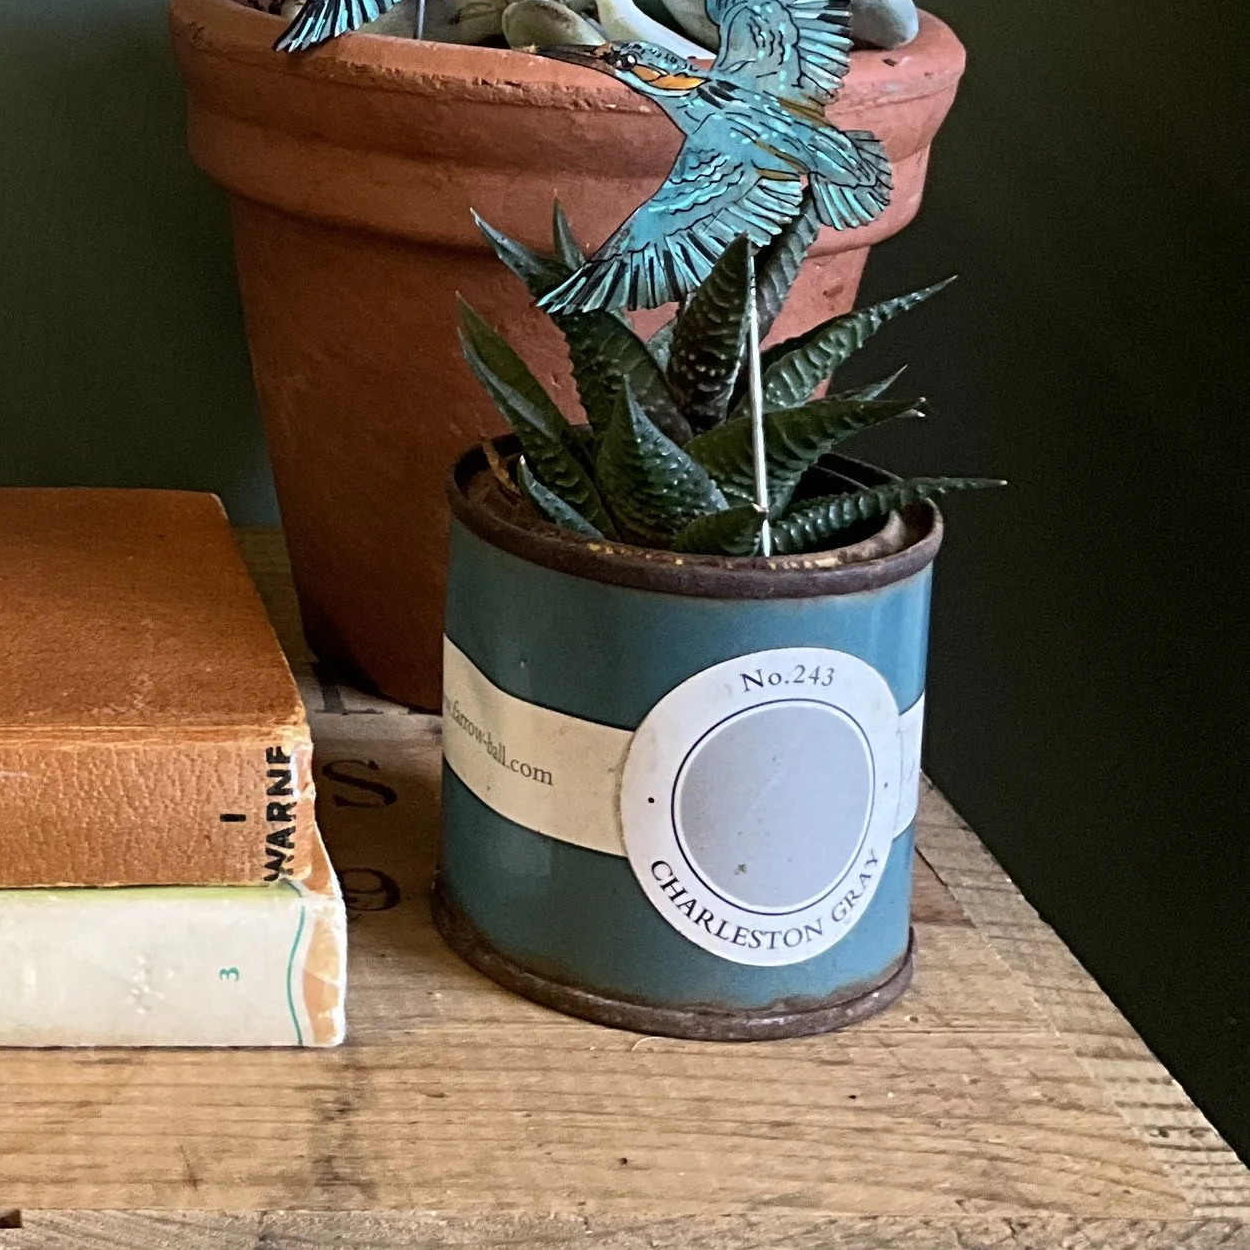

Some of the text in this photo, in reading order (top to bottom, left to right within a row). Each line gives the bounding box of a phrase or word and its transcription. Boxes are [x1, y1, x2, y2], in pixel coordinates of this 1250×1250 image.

[739, 663, 836, 693] No.243
[650, 847, 879, 950] CHARLESTON GRAY
